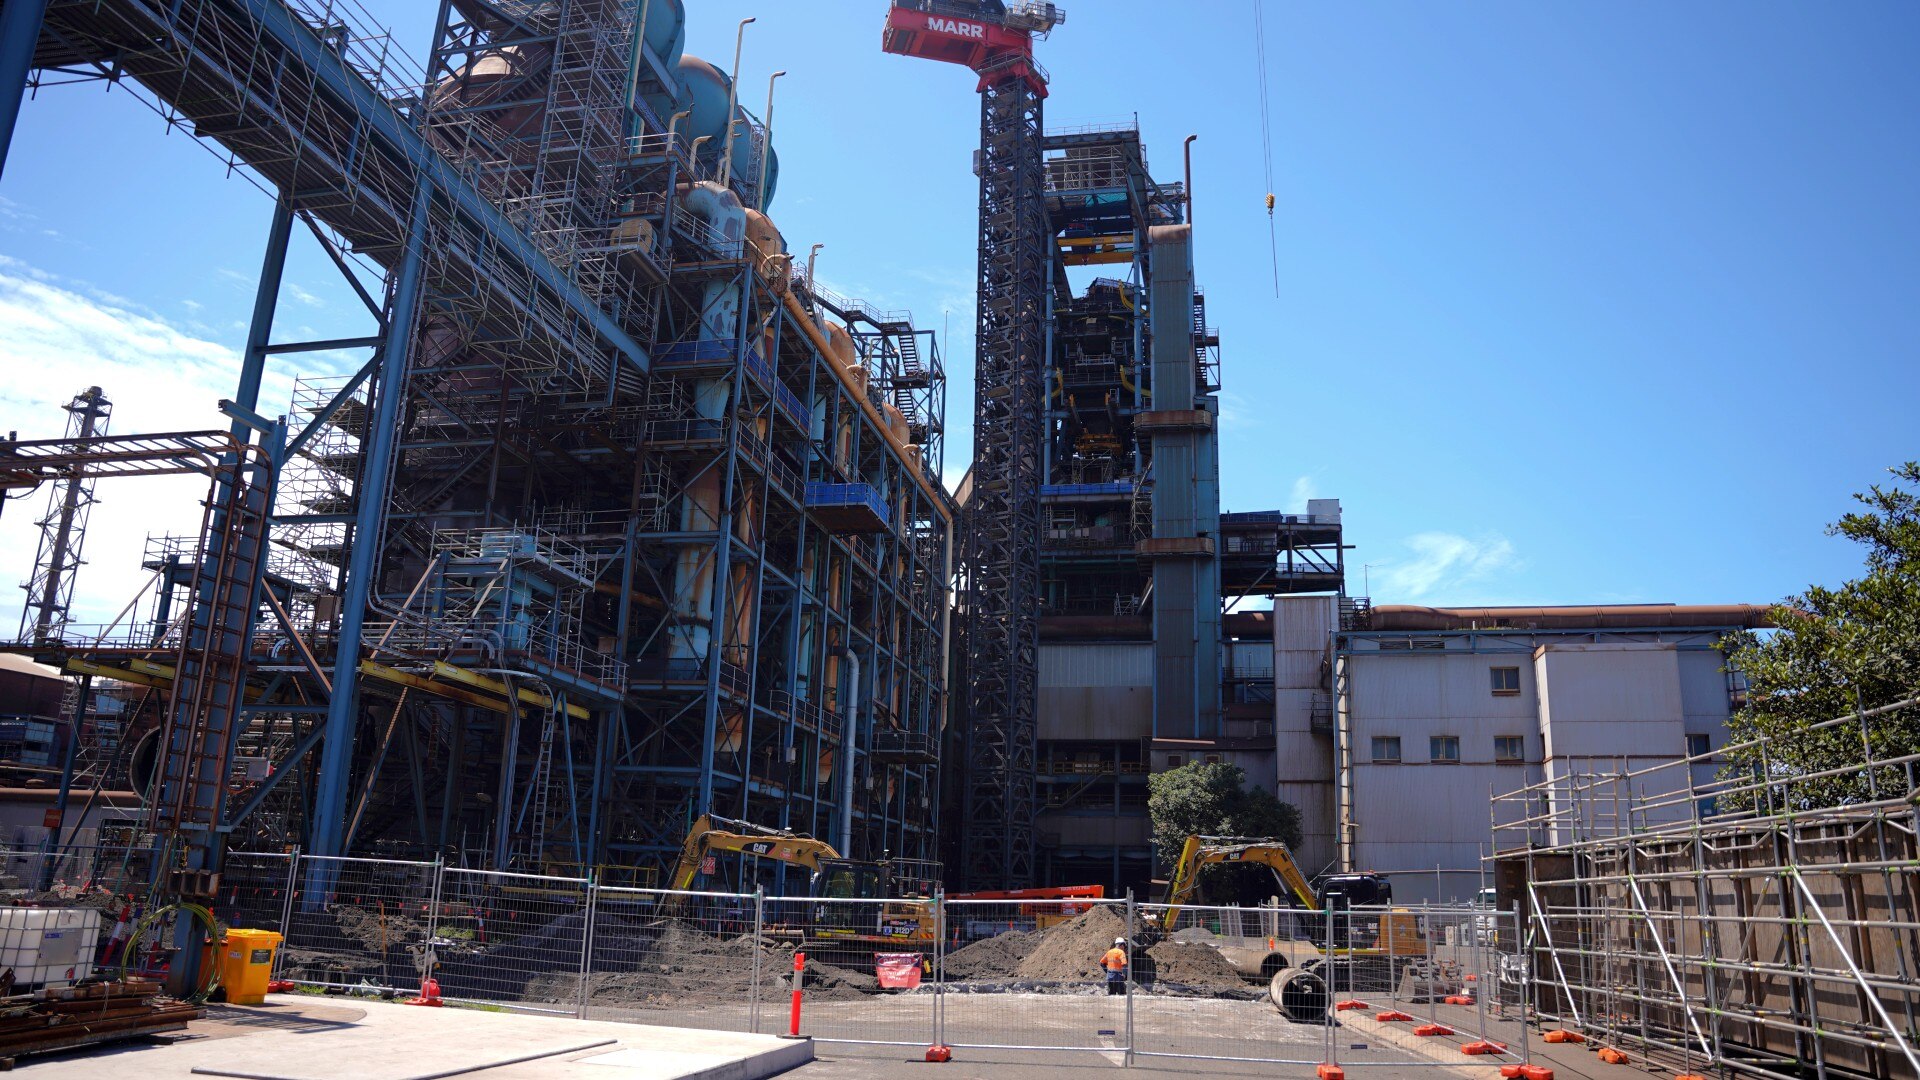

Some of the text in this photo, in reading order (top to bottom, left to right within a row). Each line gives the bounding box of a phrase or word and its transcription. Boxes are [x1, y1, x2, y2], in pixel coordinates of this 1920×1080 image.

[928, 17, 983, 38] MARR
[753, 843, 767, 854] CAT
[895, 926, 910, 935] 312D
[883, 957, 912, 965] DANGER
